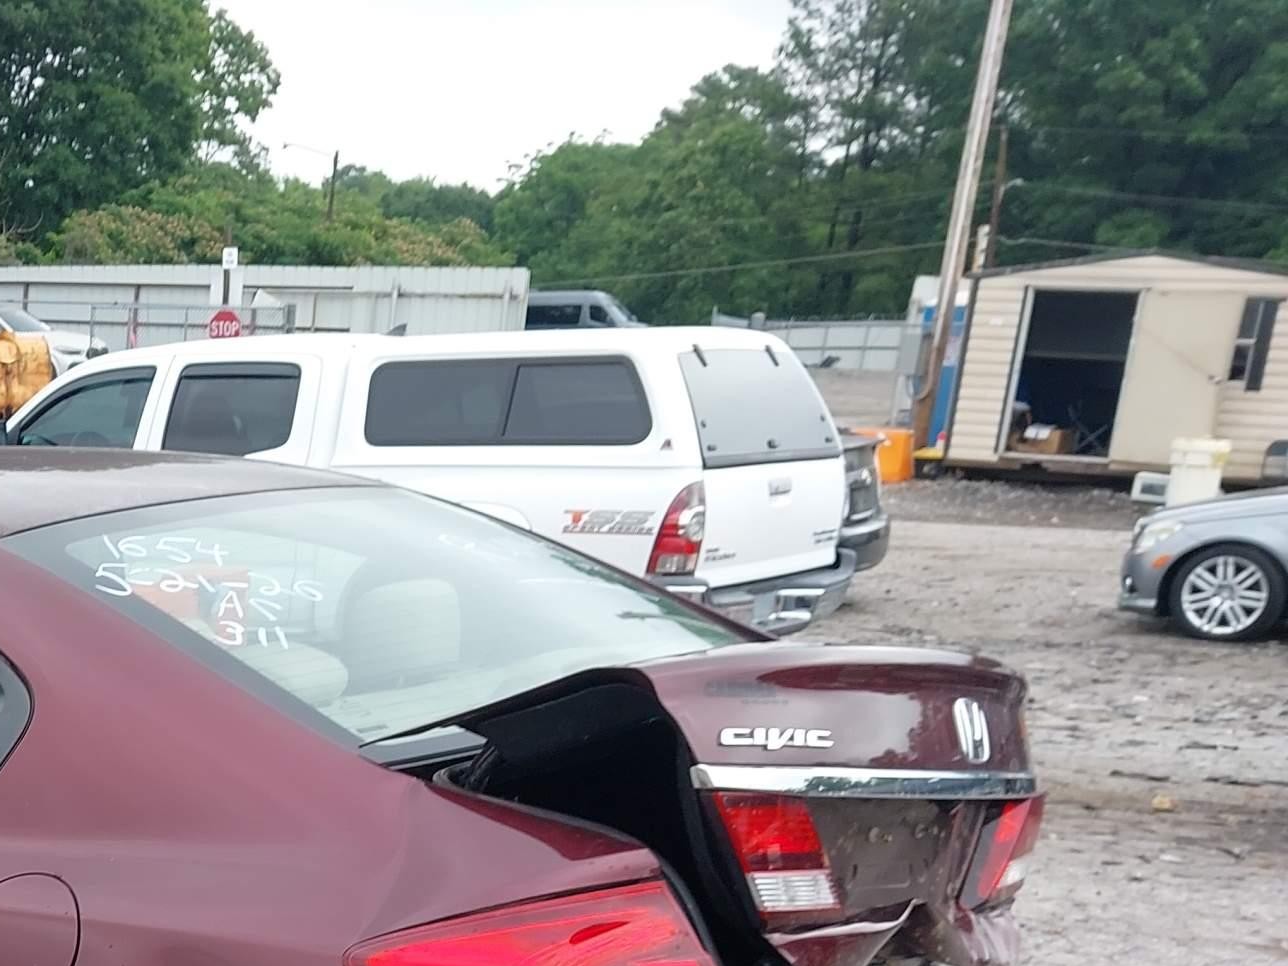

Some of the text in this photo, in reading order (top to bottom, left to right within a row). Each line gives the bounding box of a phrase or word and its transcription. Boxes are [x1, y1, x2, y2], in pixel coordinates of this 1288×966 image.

[210, 320, 240, 337] STOP
[102, 534, 230, 567] 1654
[720, 726, 835, 751] CIVIC
